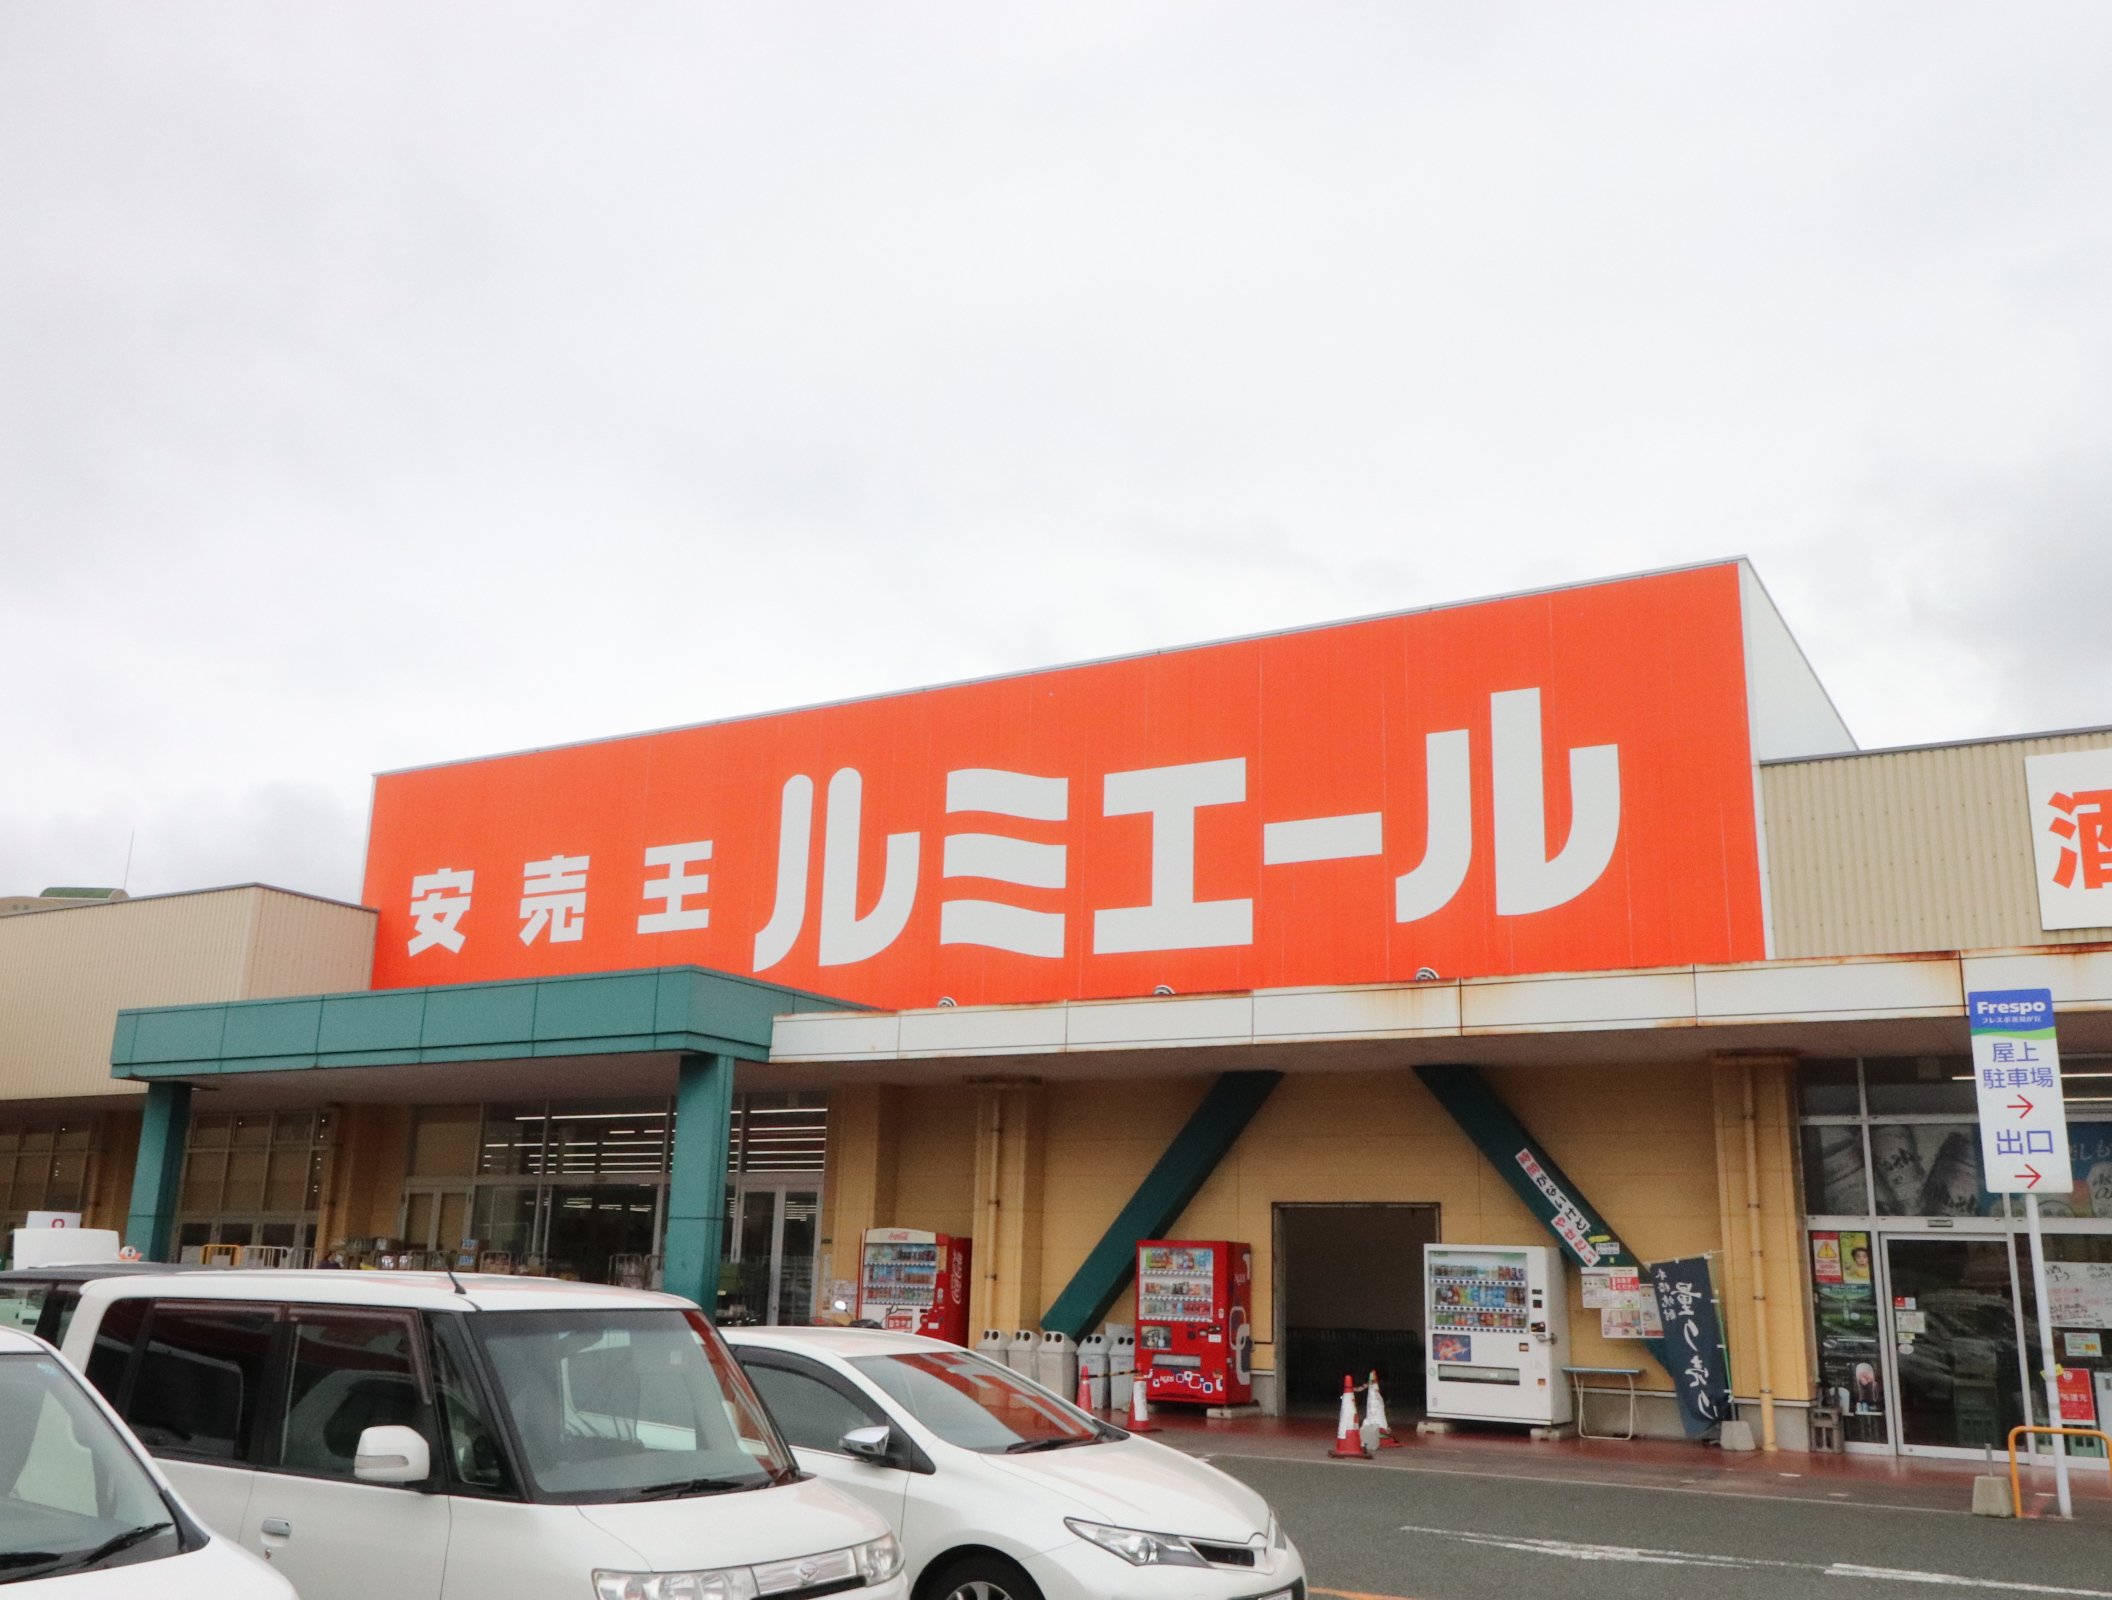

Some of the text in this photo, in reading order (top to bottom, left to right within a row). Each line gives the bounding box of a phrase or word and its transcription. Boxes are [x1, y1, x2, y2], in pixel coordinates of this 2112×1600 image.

[407, 686, 1622, 974] 安売王 ルミエール
[1976, 1001, 2047, 1015] Frespo
[1992, 1041, 2040, 1063] 屋上
[1982, 1067, 2054, 1090] 駐車場
[1996, 1129, 2054, 1156] 出口
